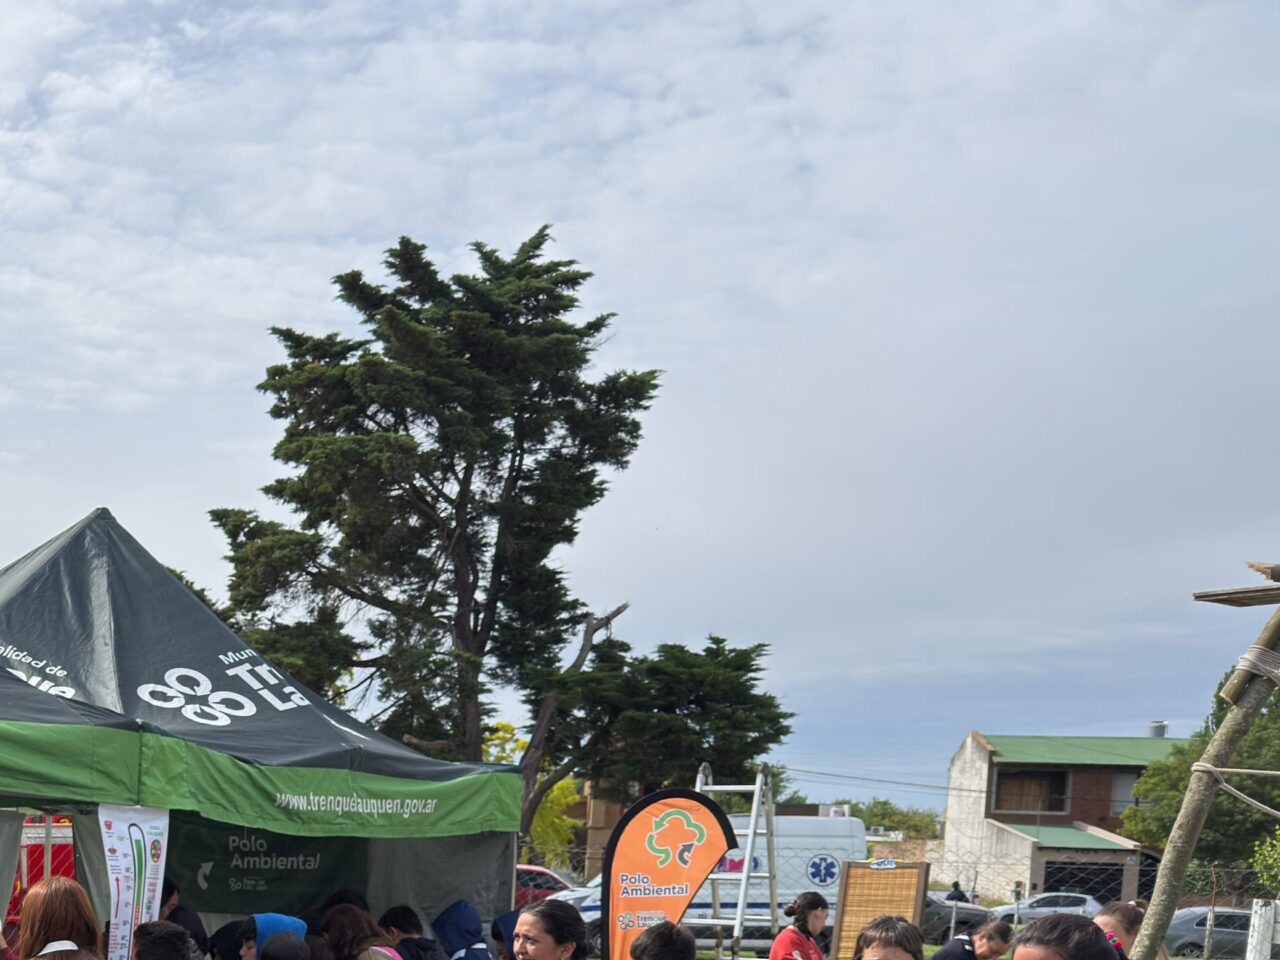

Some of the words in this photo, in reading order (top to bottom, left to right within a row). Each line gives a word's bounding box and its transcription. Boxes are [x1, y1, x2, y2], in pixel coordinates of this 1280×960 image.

[228, 836, 268, 851] Polo
[230, 853, 320, 870] Ambiental
[620, 873, 650, 885] Polo
[620, 884, 689, 896] Ambiental
